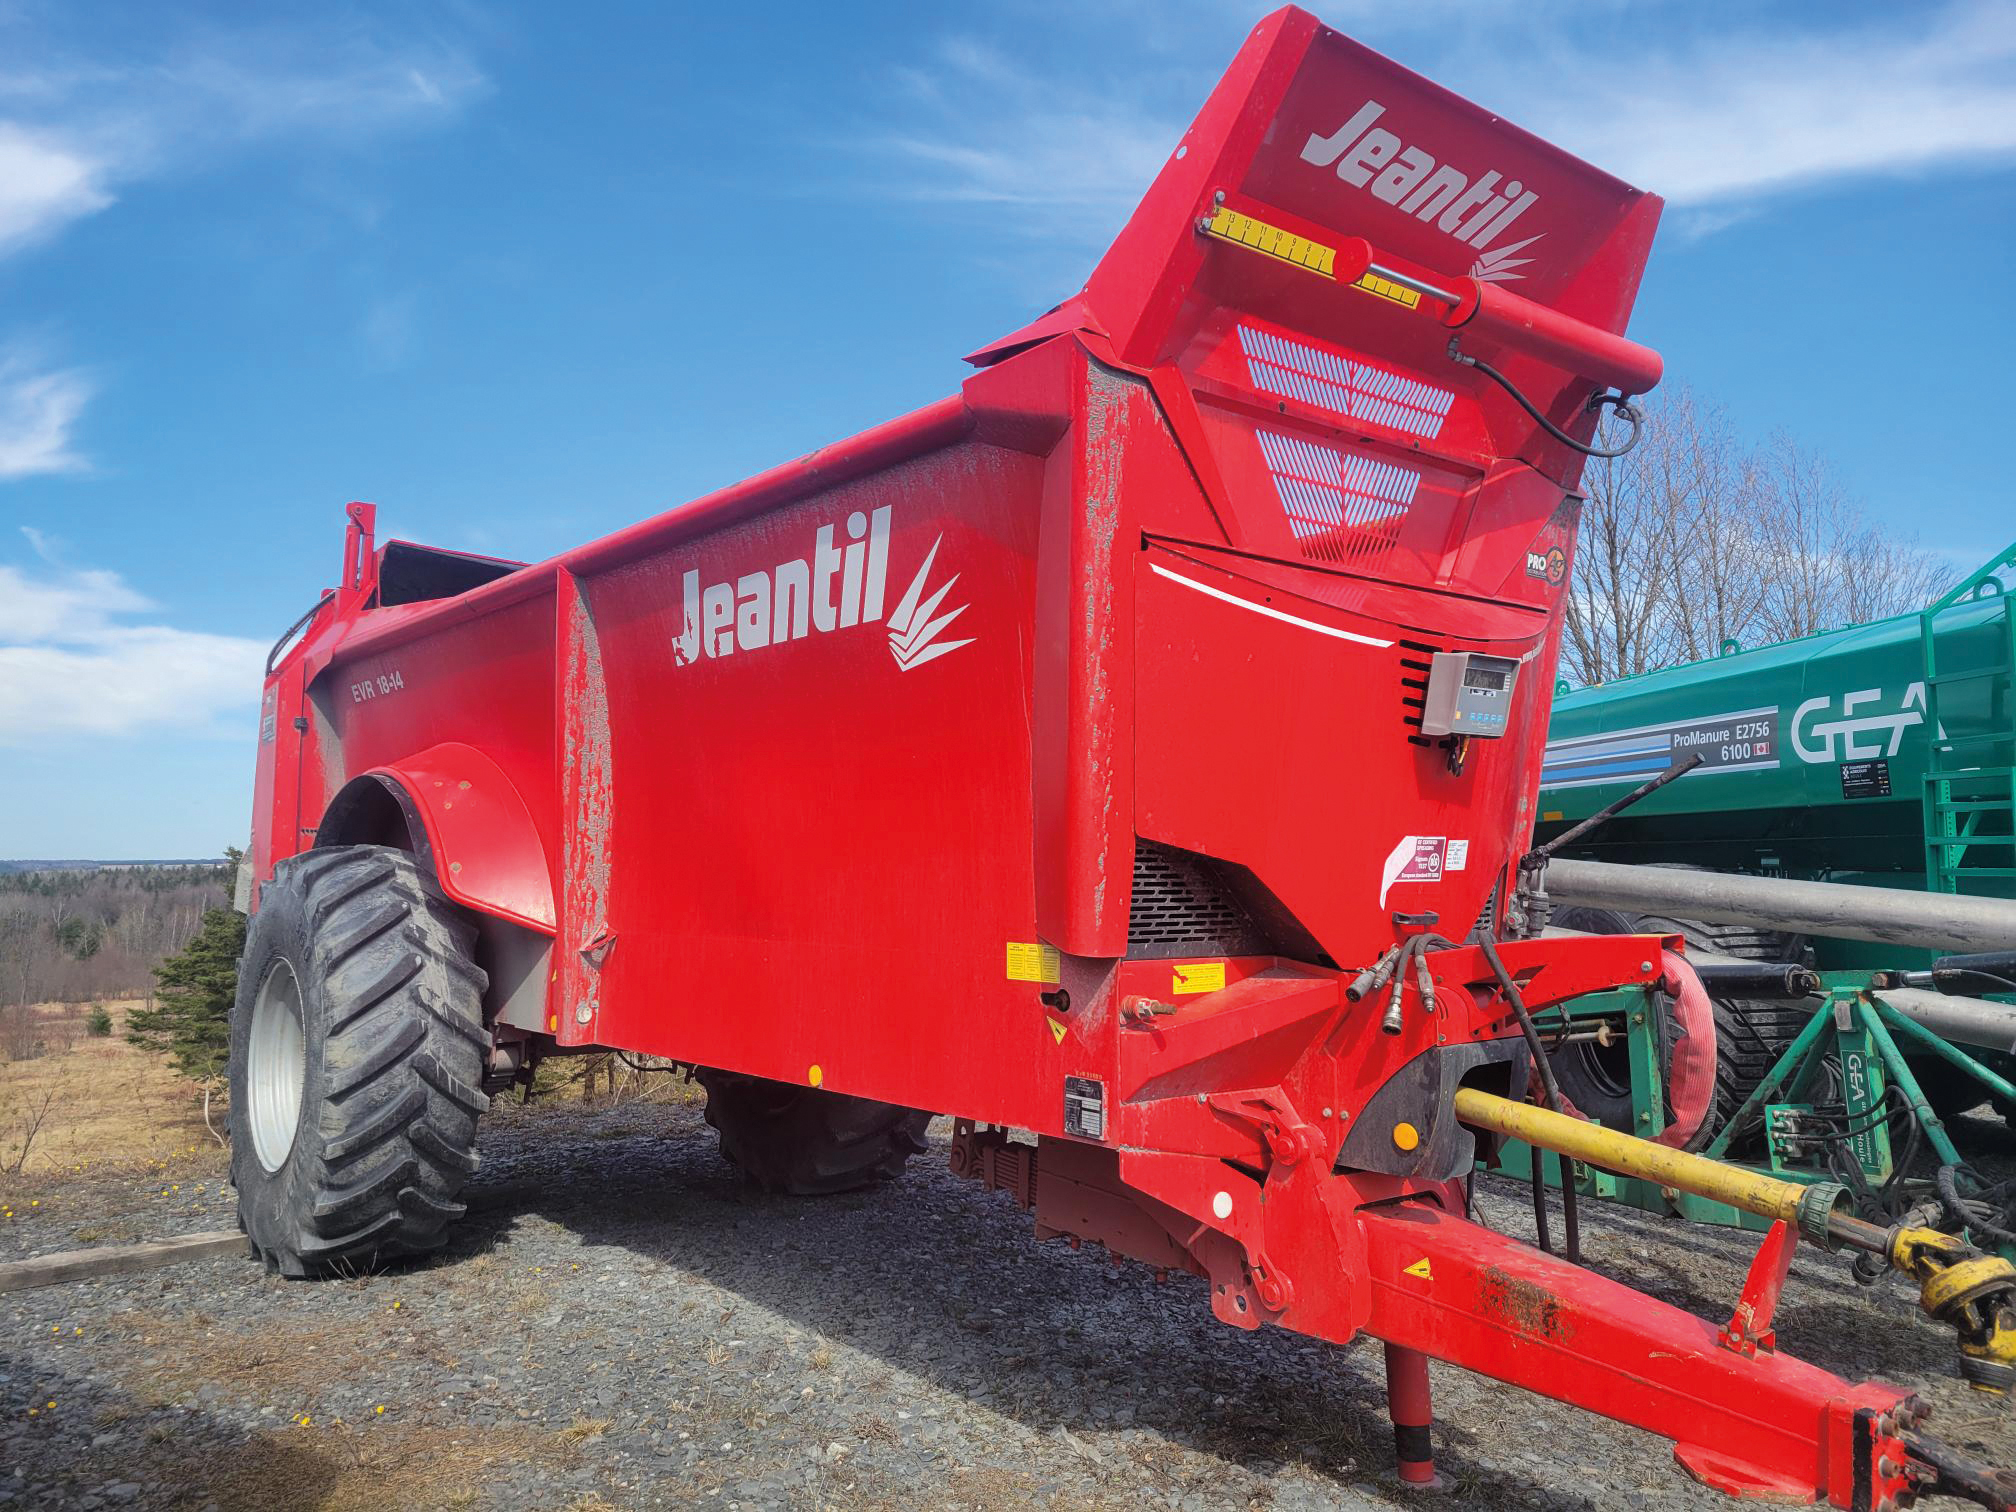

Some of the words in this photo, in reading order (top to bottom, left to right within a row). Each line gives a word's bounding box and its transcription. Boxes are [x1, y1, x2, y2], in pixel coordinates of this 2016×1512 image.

[1300, 99, 1540, 251] Jeantil
[1227, 213, 1235, 224] 13
[1244, 220, 1252, 230] 12
[1260, 226, 1268, 236] 11
[1275, 232, 1283, 242] 10
[1291, 238, 1297, 247] 9
[1306, 243, 1312, 252] 8
[1321, 249, 1327, 258] 7
[1527, 553, 1547, 571] PRO
[671, 504, 892, 667] Jeantil
[351, 680, 376, 703] EVR
[376, 670, 404, 696] 18-14
[1674, 729, 1730, 748] ProManure
[1736, 721, 1770, 740] E2756
[1791, 681, 1953, 764] GEA
[1721, 743, 1751, 761] 6100
[1848, 1054, 1865, 1102] GEA
[1857, 1134, 1866, 1163] Houle
